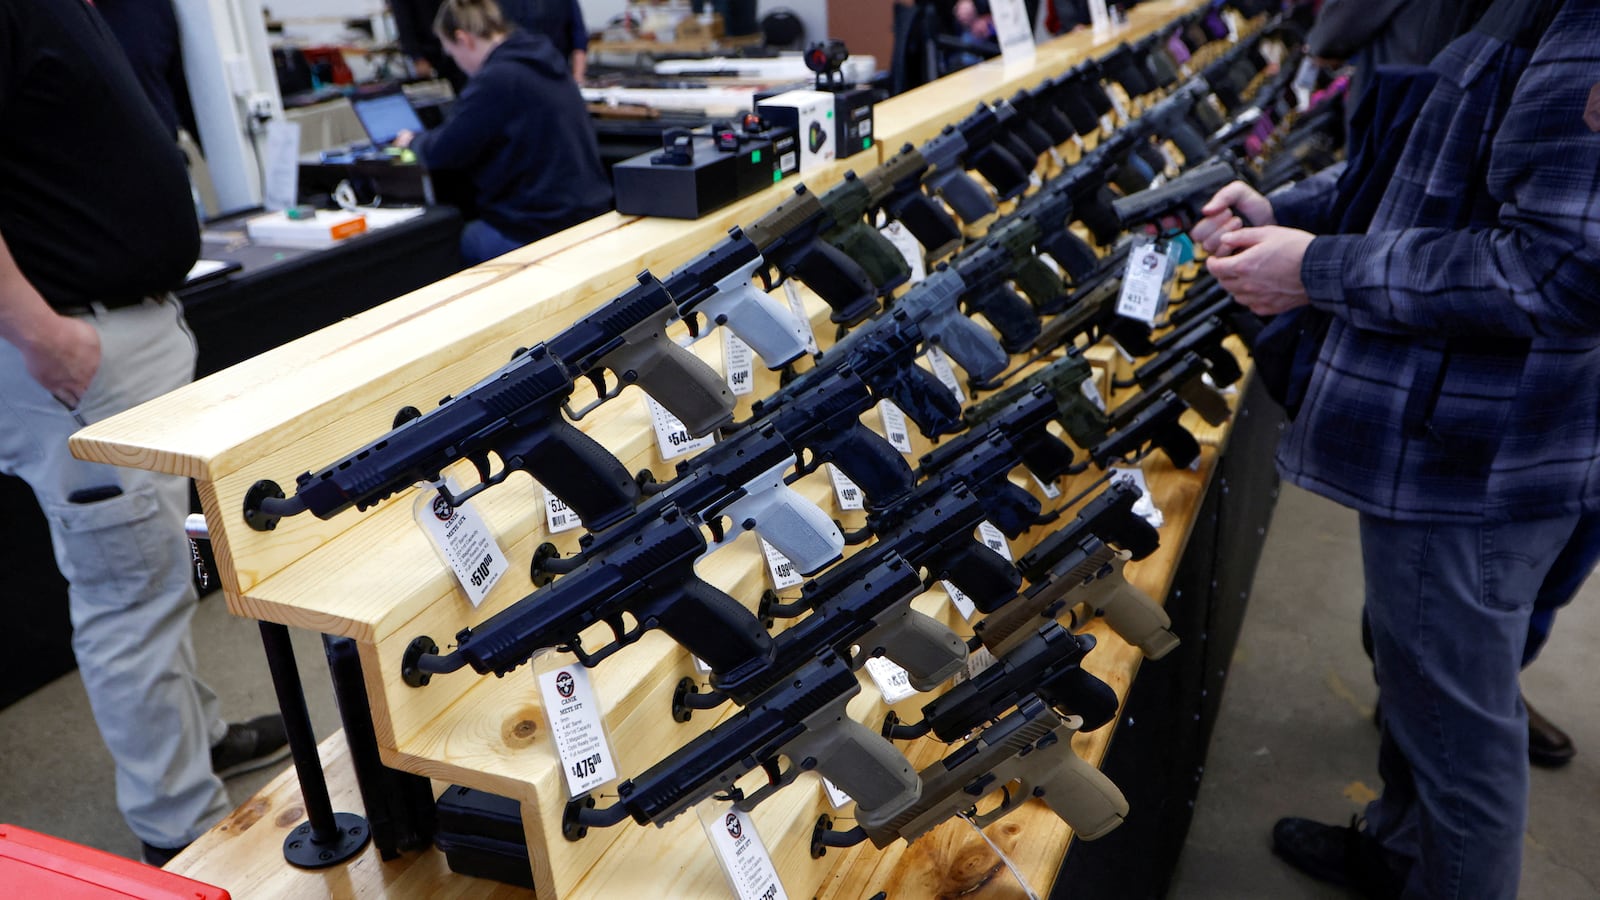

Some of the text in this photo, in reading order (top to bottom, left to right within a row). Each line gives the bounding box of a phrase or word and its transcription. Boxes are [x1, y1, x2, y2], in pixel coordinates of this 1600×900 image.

[445, 512, 459, 529] CANIK
[446, 524, 459, 538] METE
[561, 696, 577, 705] CANIK
[560, 706, 574, 715] METE
[577, 724, 592, 732] Capacity
[569, 733, 588, 743] Magazines
